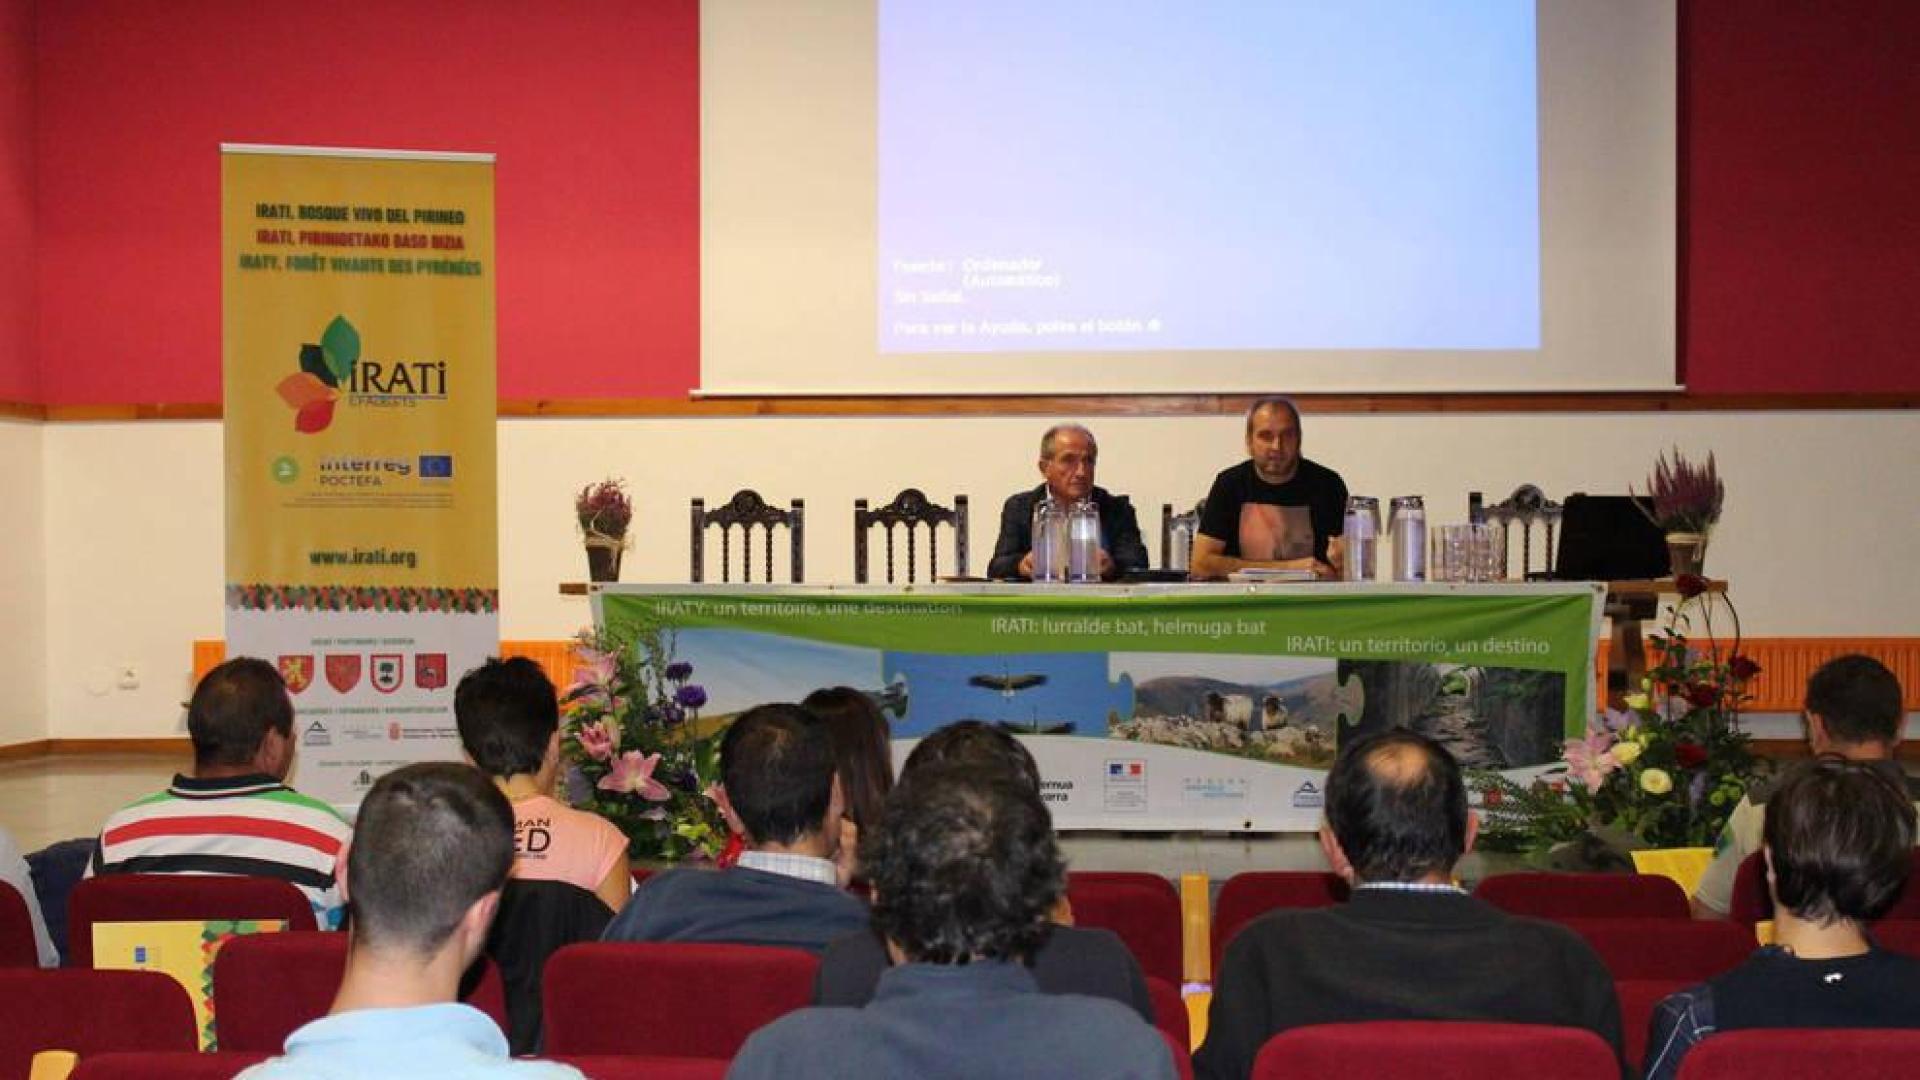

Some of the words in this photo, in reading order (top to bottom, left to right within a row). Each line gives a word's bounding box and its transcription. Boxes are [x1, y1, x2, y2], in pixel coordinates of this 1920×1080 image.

[298, 205, 349, 221] BOSQUE
[353, 206, 383, 222] VIVO
[386, 208, 410, 224] DEL
[414, 208, 465, 225] PIRINEO
[350, 361, 447, 394] iRATi
[319, 474, 383, 487] POCTEFA
[309, 548, 416, 568] www.irati.org
[714, 604, 737, 616] un
[992, 617, 1038, 634] IRATI:
[1043, 616, 1110, 635] lurralde
[1116, 617, 1149, 636] bat,
[1153, 616, 1232, 639] helmuga
[1237, 616, 1266, 635] bat
[1287, 636, 1334, 653] IRATI:
[1339, 639, 1362, 653] un
[1368, 636, 1449, 655] territorio,
[1455, 639, 1478, 654] un
[1483, 636, 1550, 655] destino
[1040, 779, 1073, 790] ernua
